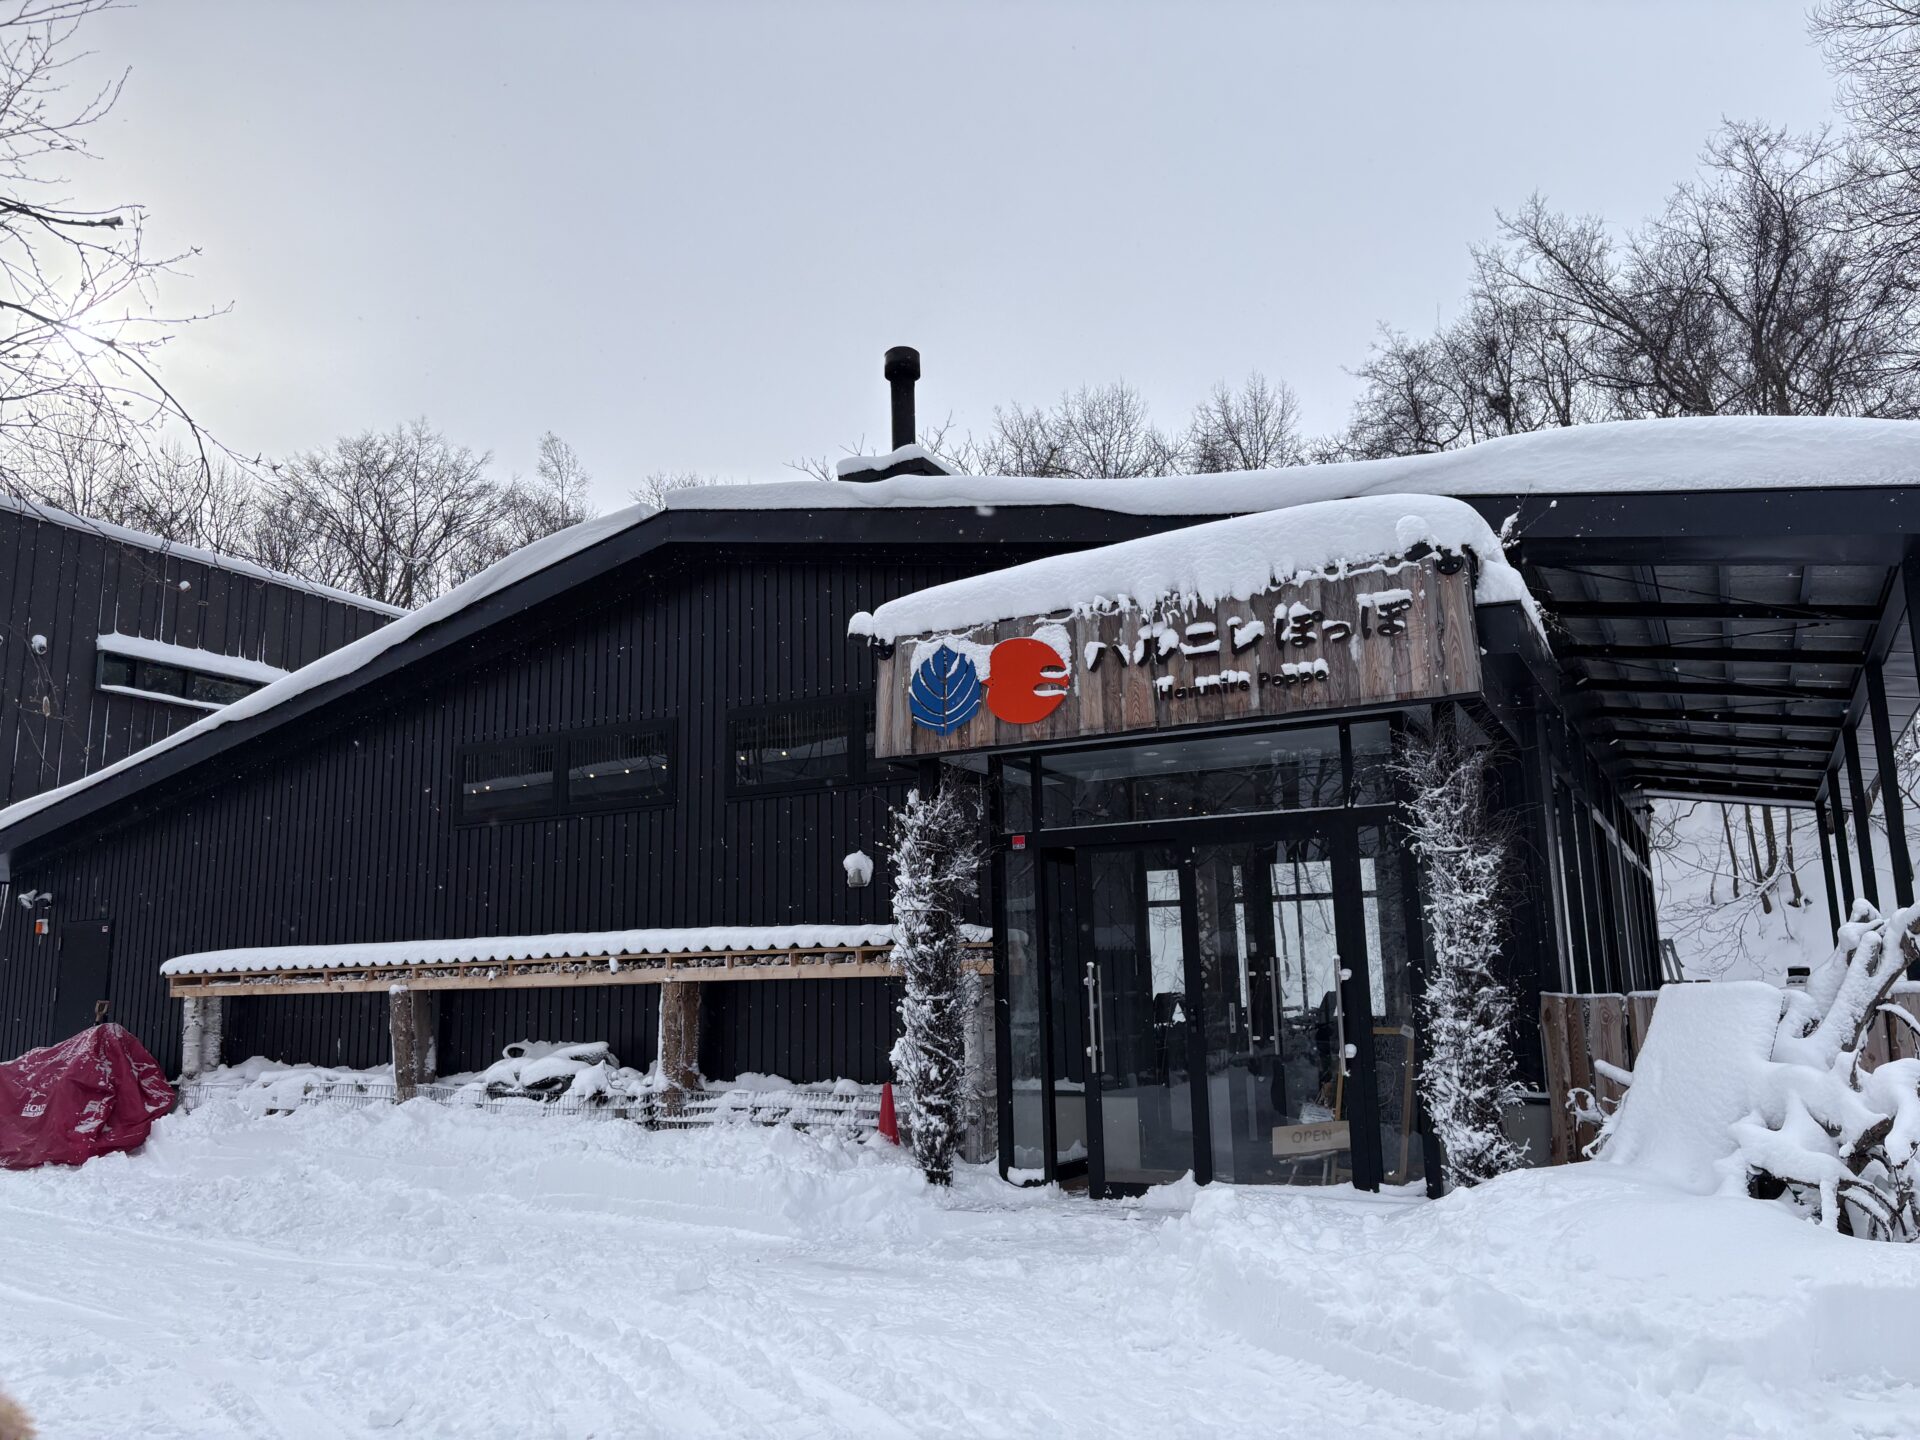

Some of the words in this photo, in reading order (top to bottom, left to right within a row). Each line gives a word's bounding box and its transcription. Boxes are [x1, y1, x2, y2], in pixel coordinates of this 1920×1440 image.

[1156, 674, 1251, 701] Harunire
[1259, 668, 1329, 689] Poppo
[1291, 1128, 1332, 1143] OPEN
